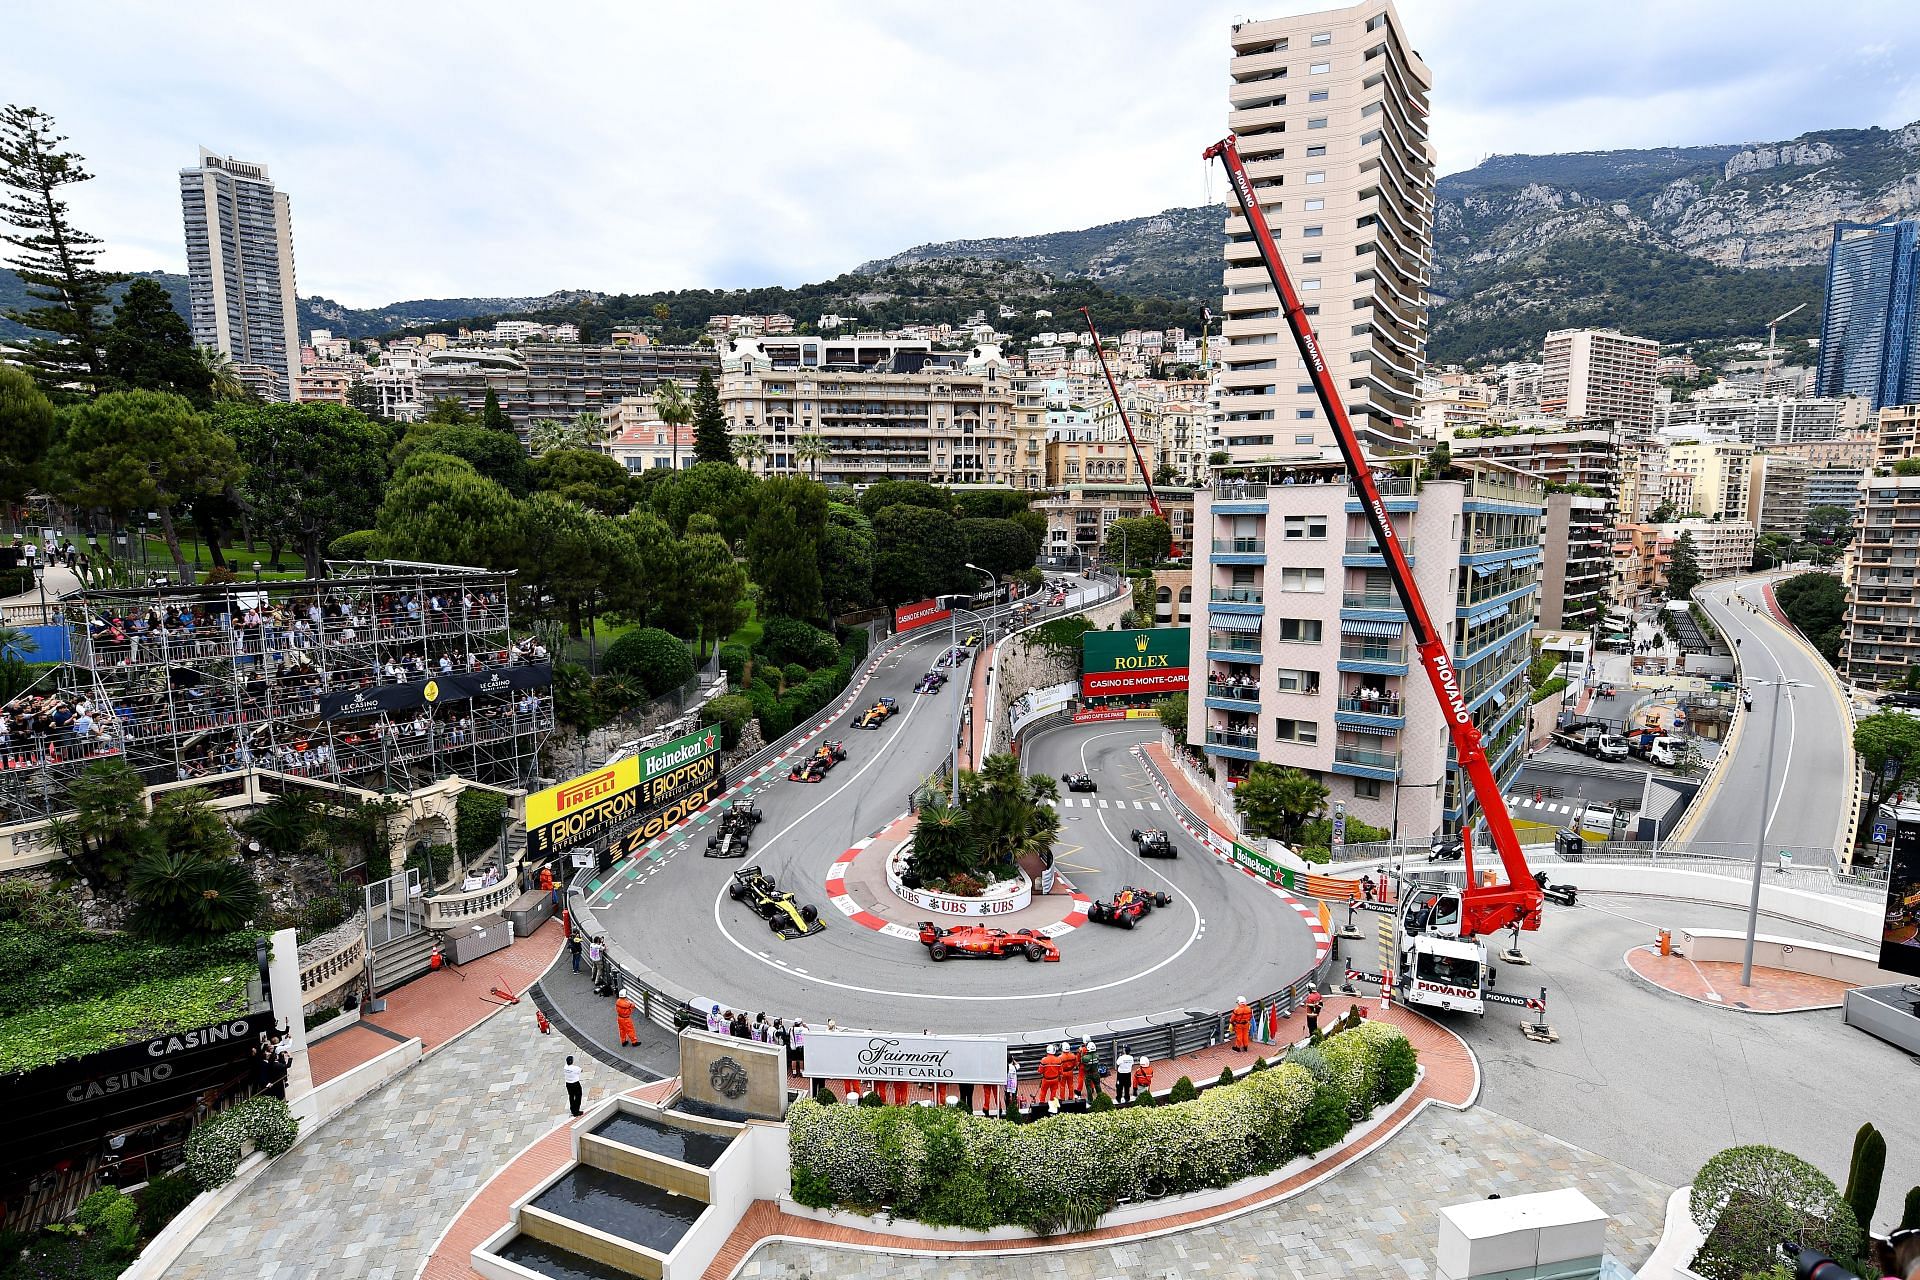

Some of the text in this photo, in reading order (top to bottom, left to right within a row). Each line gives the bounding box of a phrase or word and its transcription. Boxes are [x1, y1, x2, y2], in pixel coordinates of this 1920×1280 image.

[1234, 169, 1255, 208] PIOVANO
[1303, 333, 1324, 373] PIOVANO
[1371, 498, 1393, 539] PIOVANO
[898, 614, 913, 623] CASINO
[1114, 654, 1169, 670] ROLEX
[487, 679, 510, 688] CASINO
[1090, 678, 1122, 688] CASINO
[1123, 678, 1135, 686] DE
[1433, 654, 1470, 725] PIOVANO
[349, 700, 379, 710] CASINO
[646, 737, 702, 776] Heineken
[556, 770, 615, 811] PIRELLI
[652, 754, 714, 797] BIOPTRON
[551, 789, 637, 843] BIOPTRON
[552, 808, 636, 853] HYPERLIGHT THERAPY
[636, 843, 691, 885] TAXIS
[1236, 848, 1272, 878] Heineken
[902, 889, 920, 904] UBS
[941, 900, 967, 914] UBS
[993, 899, 1014, 914] UBS
[1418, 982, 1477, 999] PIOVANO
[1486, 993, 1524, 1005] PIOVANO
[148, 1021, 249, 1056] CASINO
[857, 1037, 952, 1067] Fairmont
[67, 1063, 173, 1102] CASINO
[857, 1065, 954, 1079] MONTE CARLO
